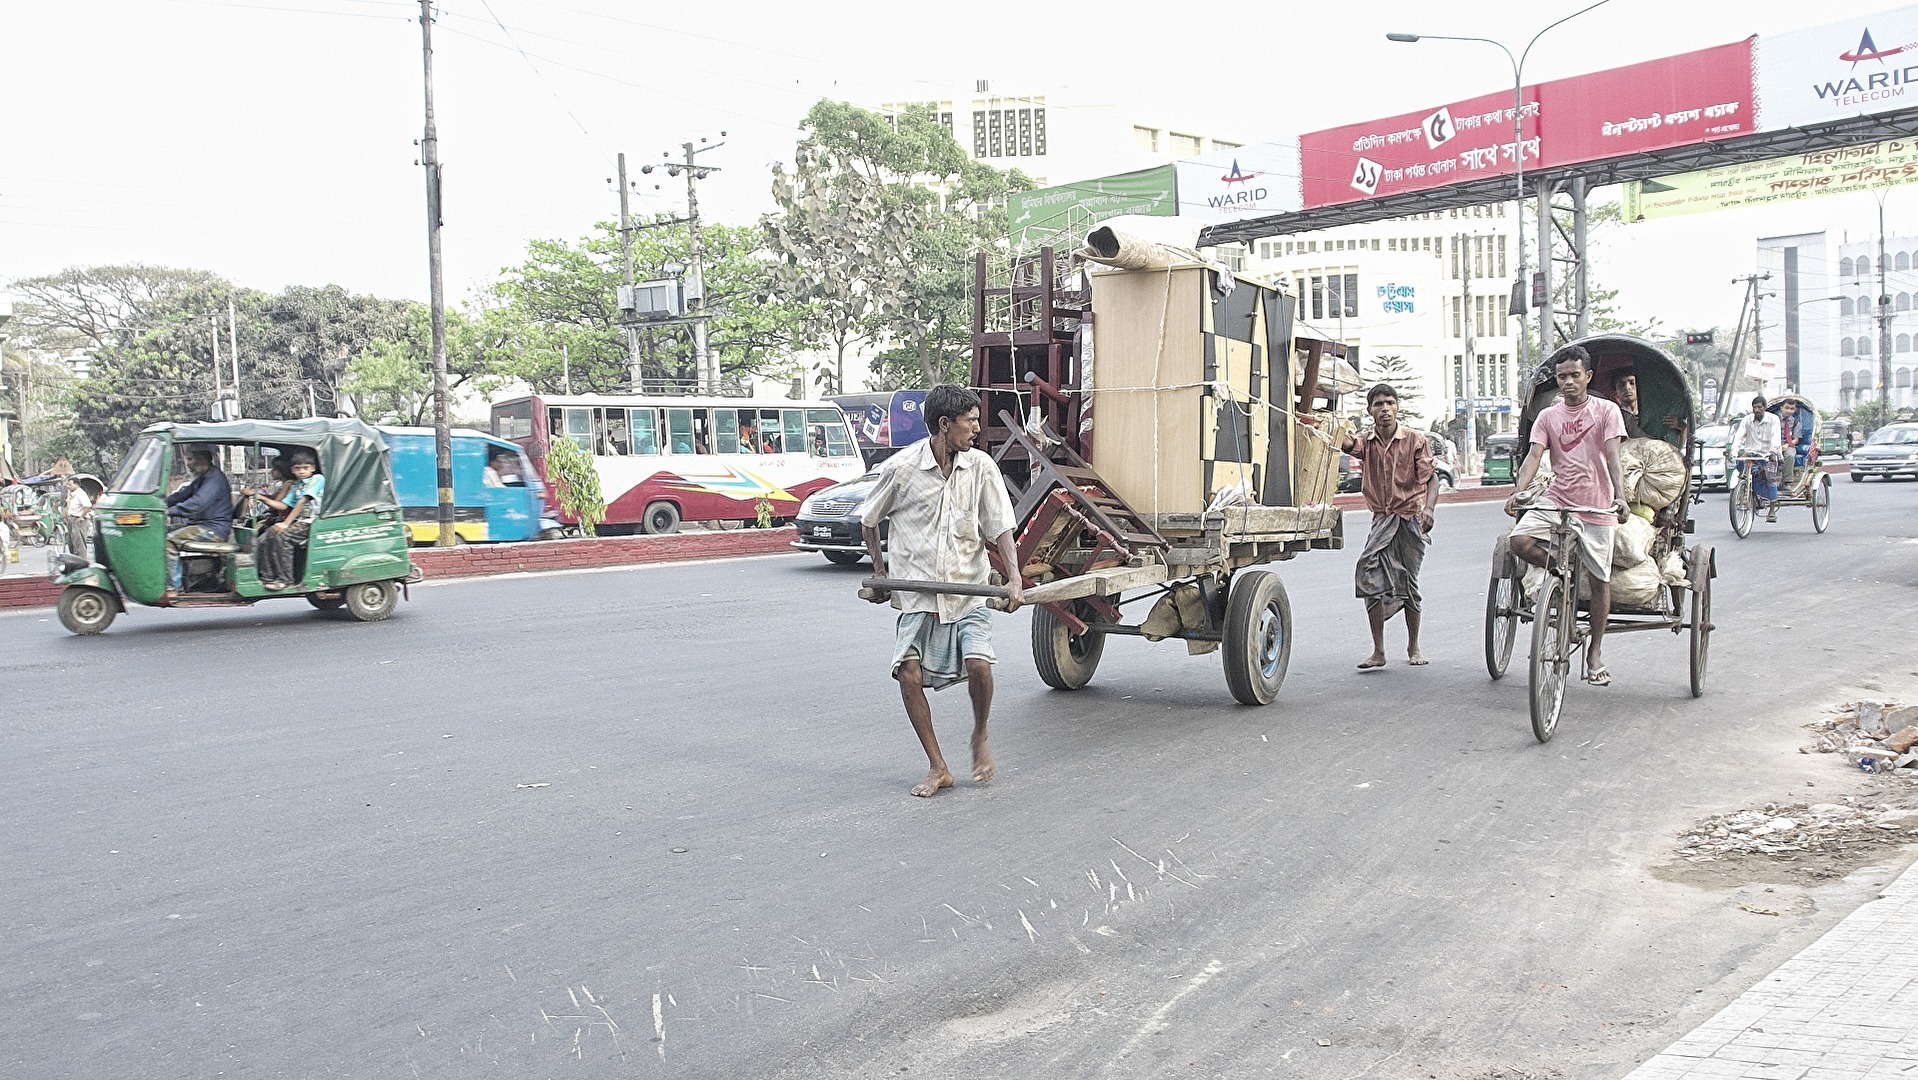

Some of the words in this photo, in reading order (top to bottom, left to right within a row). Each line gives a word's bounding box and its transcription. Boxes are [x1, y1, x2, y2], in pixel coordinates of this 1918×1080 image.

[1813, 65, 1918, 99] WARID
[1834, 87, 1905, 106] TELECOM
[1353, 134, 1385, 151] প্রতিদিন
[1430, 113, 1446, 142] ৫
[1455, 115, 1482, 130] টাকার
[1484, 109, 1503, 125] কথা
[1356, 163, 1377, 188] ১১
[1384, 168, 1404, 182] টাকা
[1428, 158, 1457, 176] বোনাস
[1460, 143, 1498, 170] সাথে
[1208, 188, 1267, 208] WARID
[1562, 419, 1583, 435] NIKE
